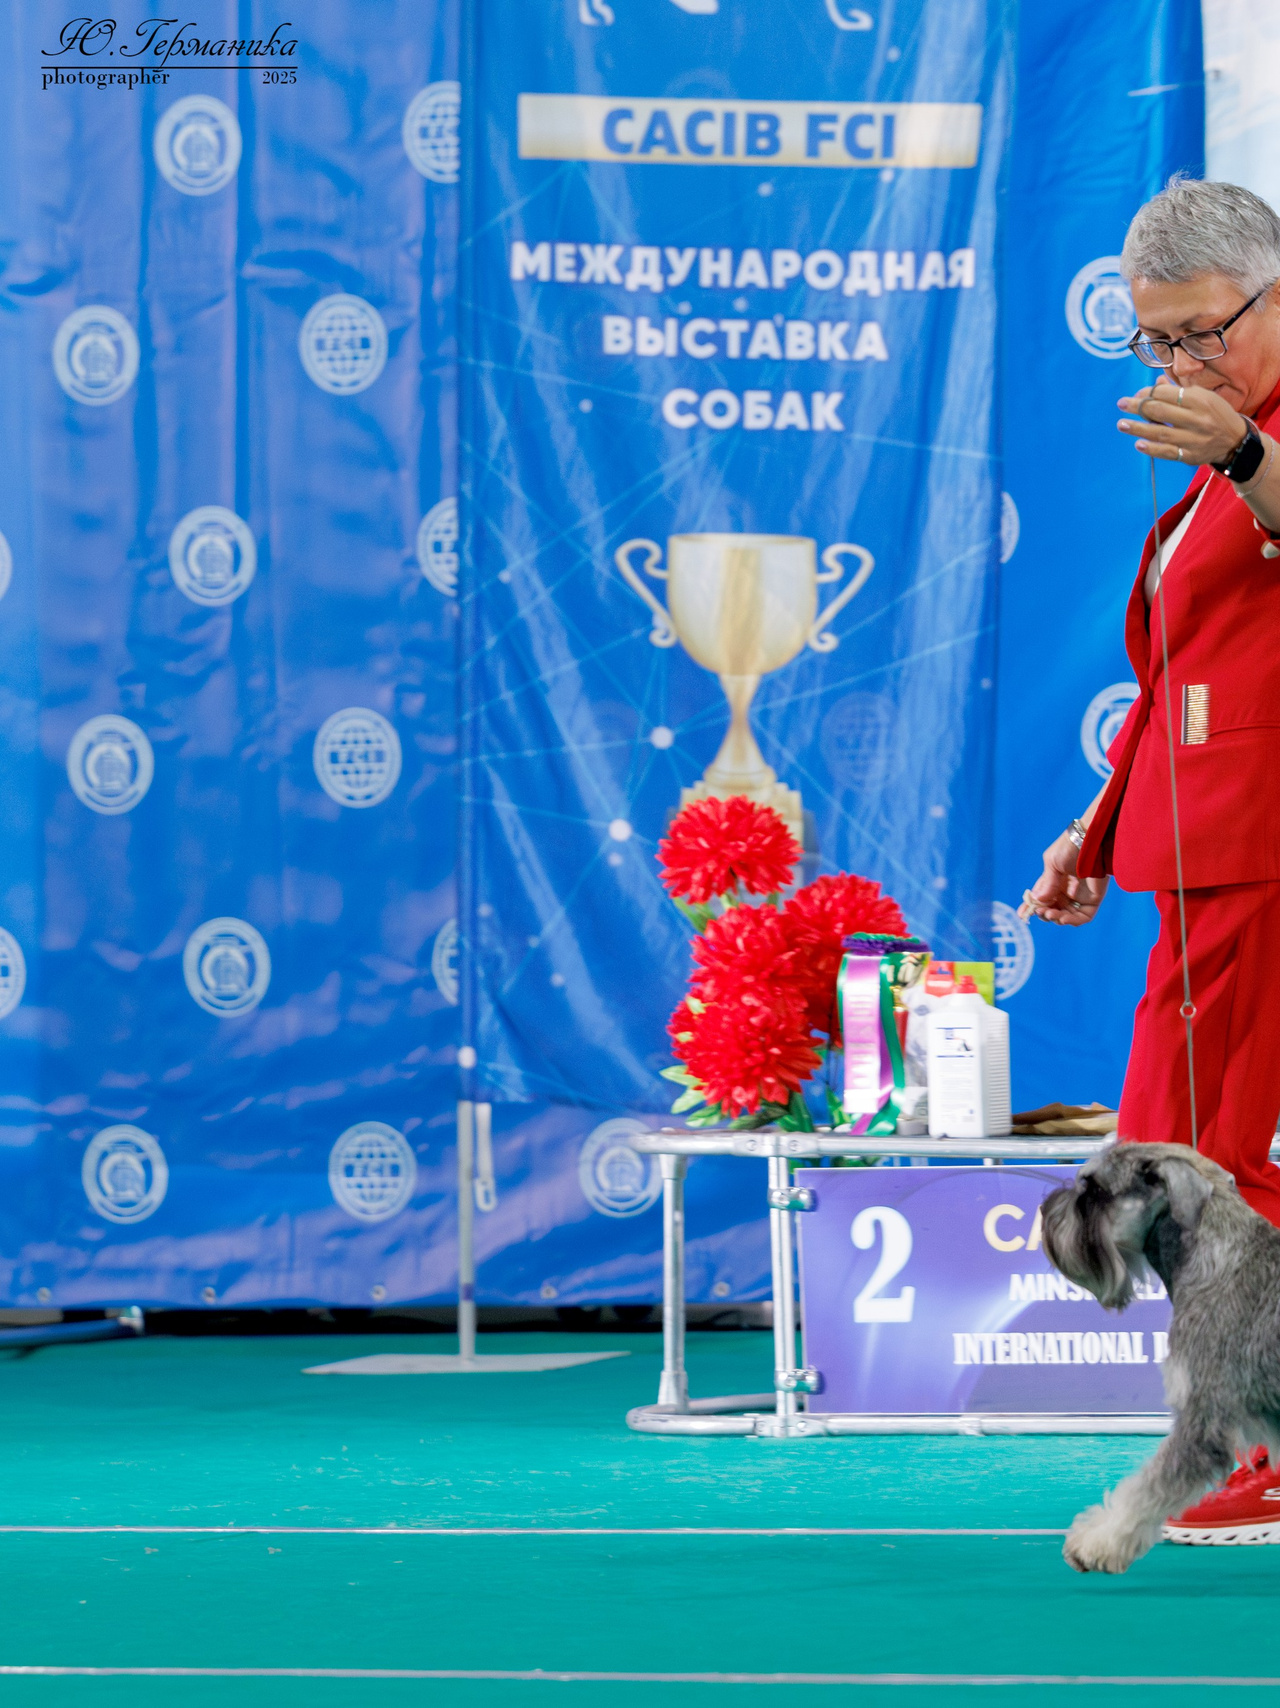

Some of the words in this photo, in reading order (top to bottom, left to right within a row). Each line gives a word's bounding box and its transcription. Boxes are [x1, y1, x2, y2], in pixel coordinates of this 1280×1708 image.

[602, 107, 782, 157] CACIB
[805, 112, 896, 160] FCI
[510, 240, 976, 298] МЕЖДУНАРОДНАЯ
[602, 315, 889, 362] ВЫСТАВКА
[662, 388, 845, 432] СОБАК
[340, 749, 376, 763] FCI
[850, 1205, 915, 1324] 2
[952, 1331, 1148, 1365] INTERNATIONAL
